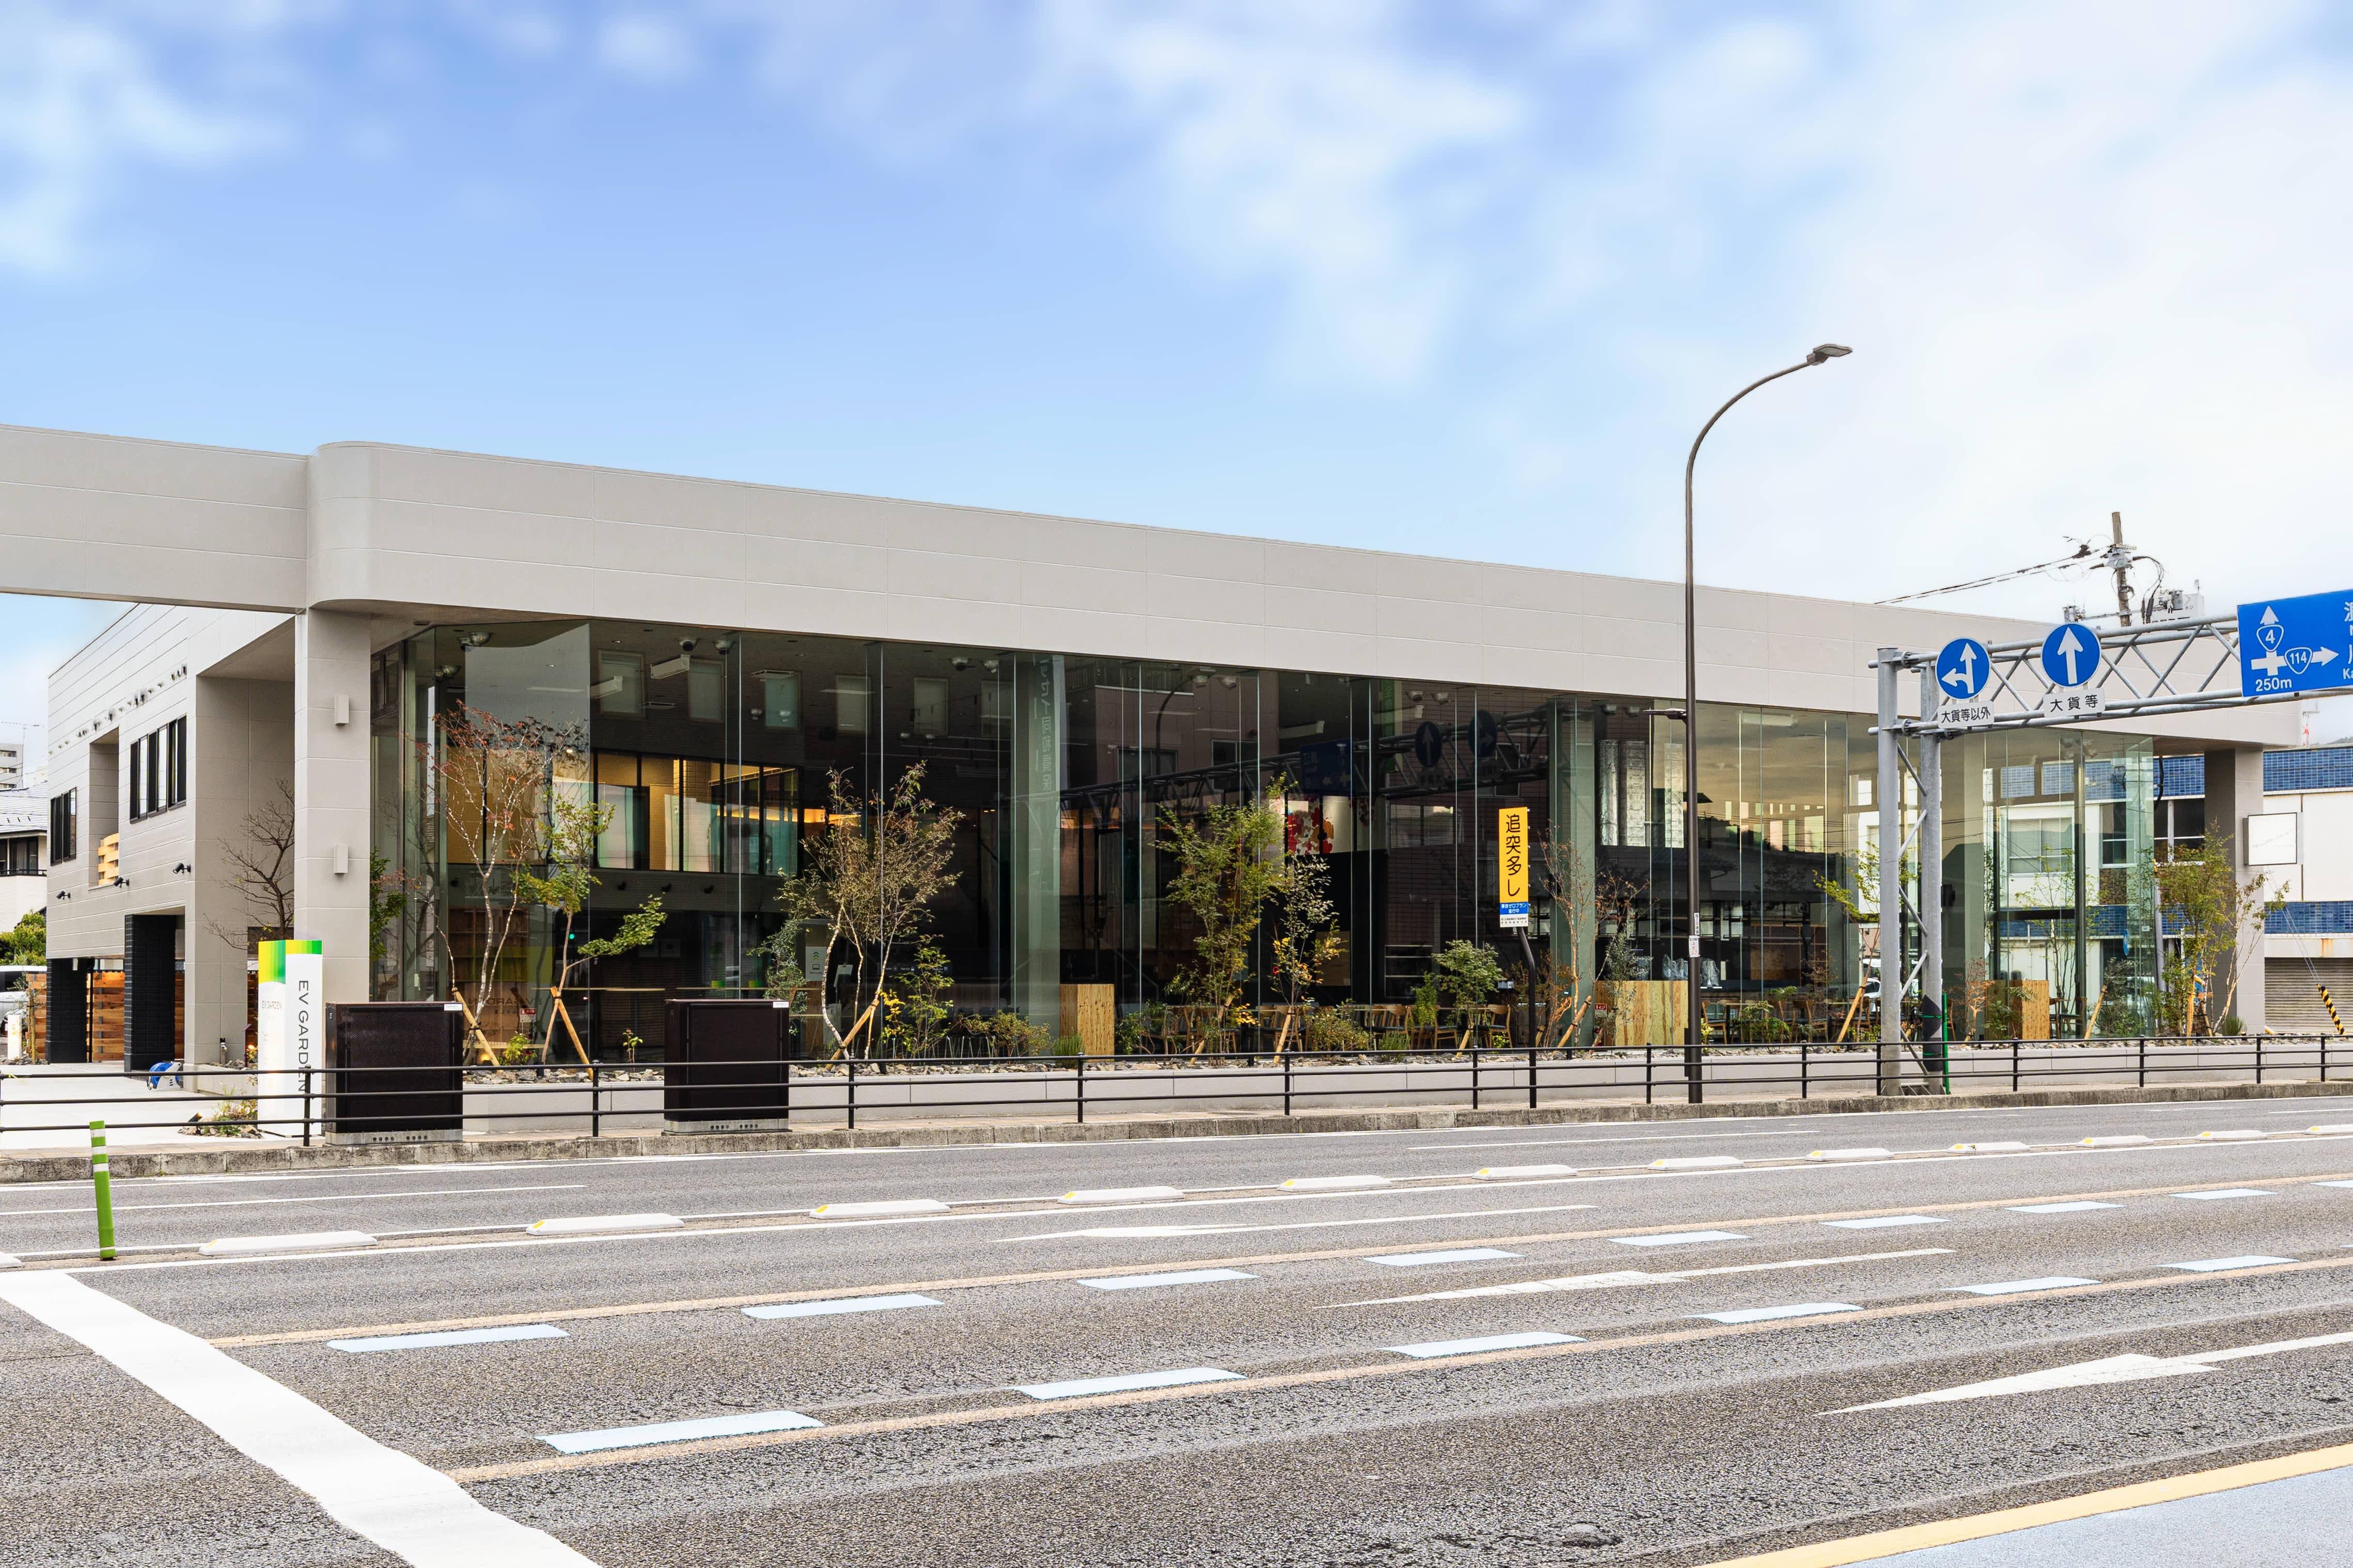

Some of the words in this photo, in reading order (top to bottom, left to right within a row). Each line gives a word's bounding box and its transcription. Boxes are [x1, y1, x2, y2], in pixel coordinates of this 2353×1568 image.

[2265, 629, 2275, 644] 4
[2290, 652, 2307, 664] 114
[2255, 677, 2293, 692] 250m
[2050, 694, 2098, 712] 大貨等
[1941, 706, 1991, 723] 大貨等以外
[1505, 814, 1521, 897] 追突多し
[299, 980, 309, 1005] EV
